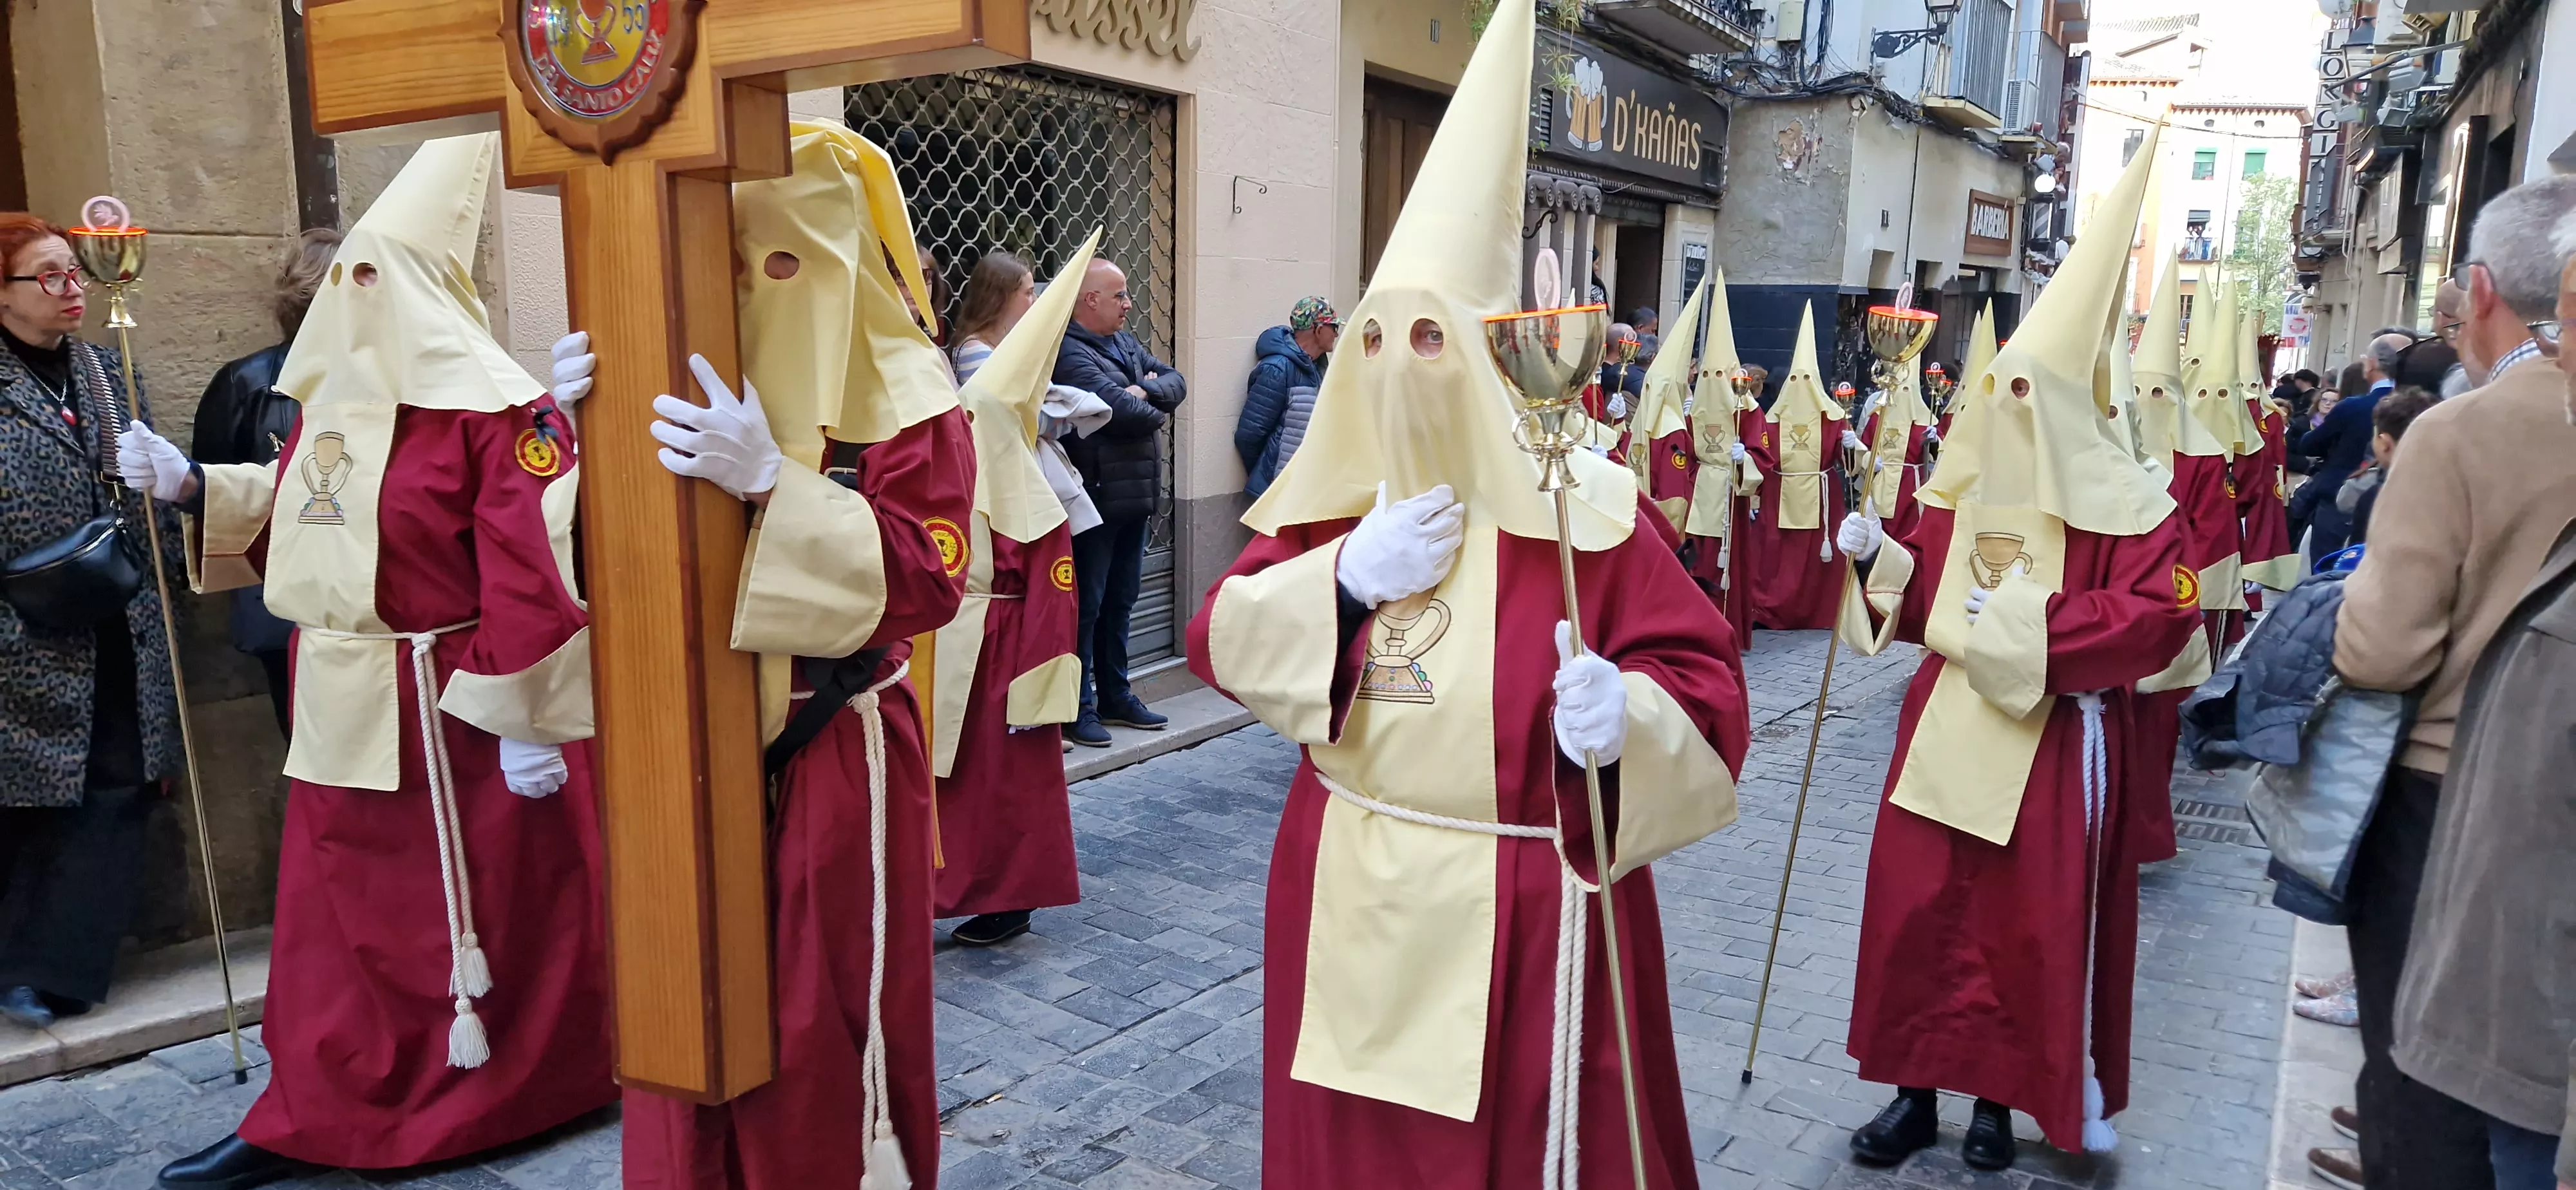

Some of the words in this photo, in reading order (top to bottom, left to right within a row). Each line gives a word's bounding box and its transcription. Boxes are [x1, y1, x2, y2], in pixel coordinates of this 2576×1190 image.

[535, 52, 560, 93] DEL
[559, 84, 624, 110] SANTO
[1613, 89, 1701, 171] D'KAÑAS
